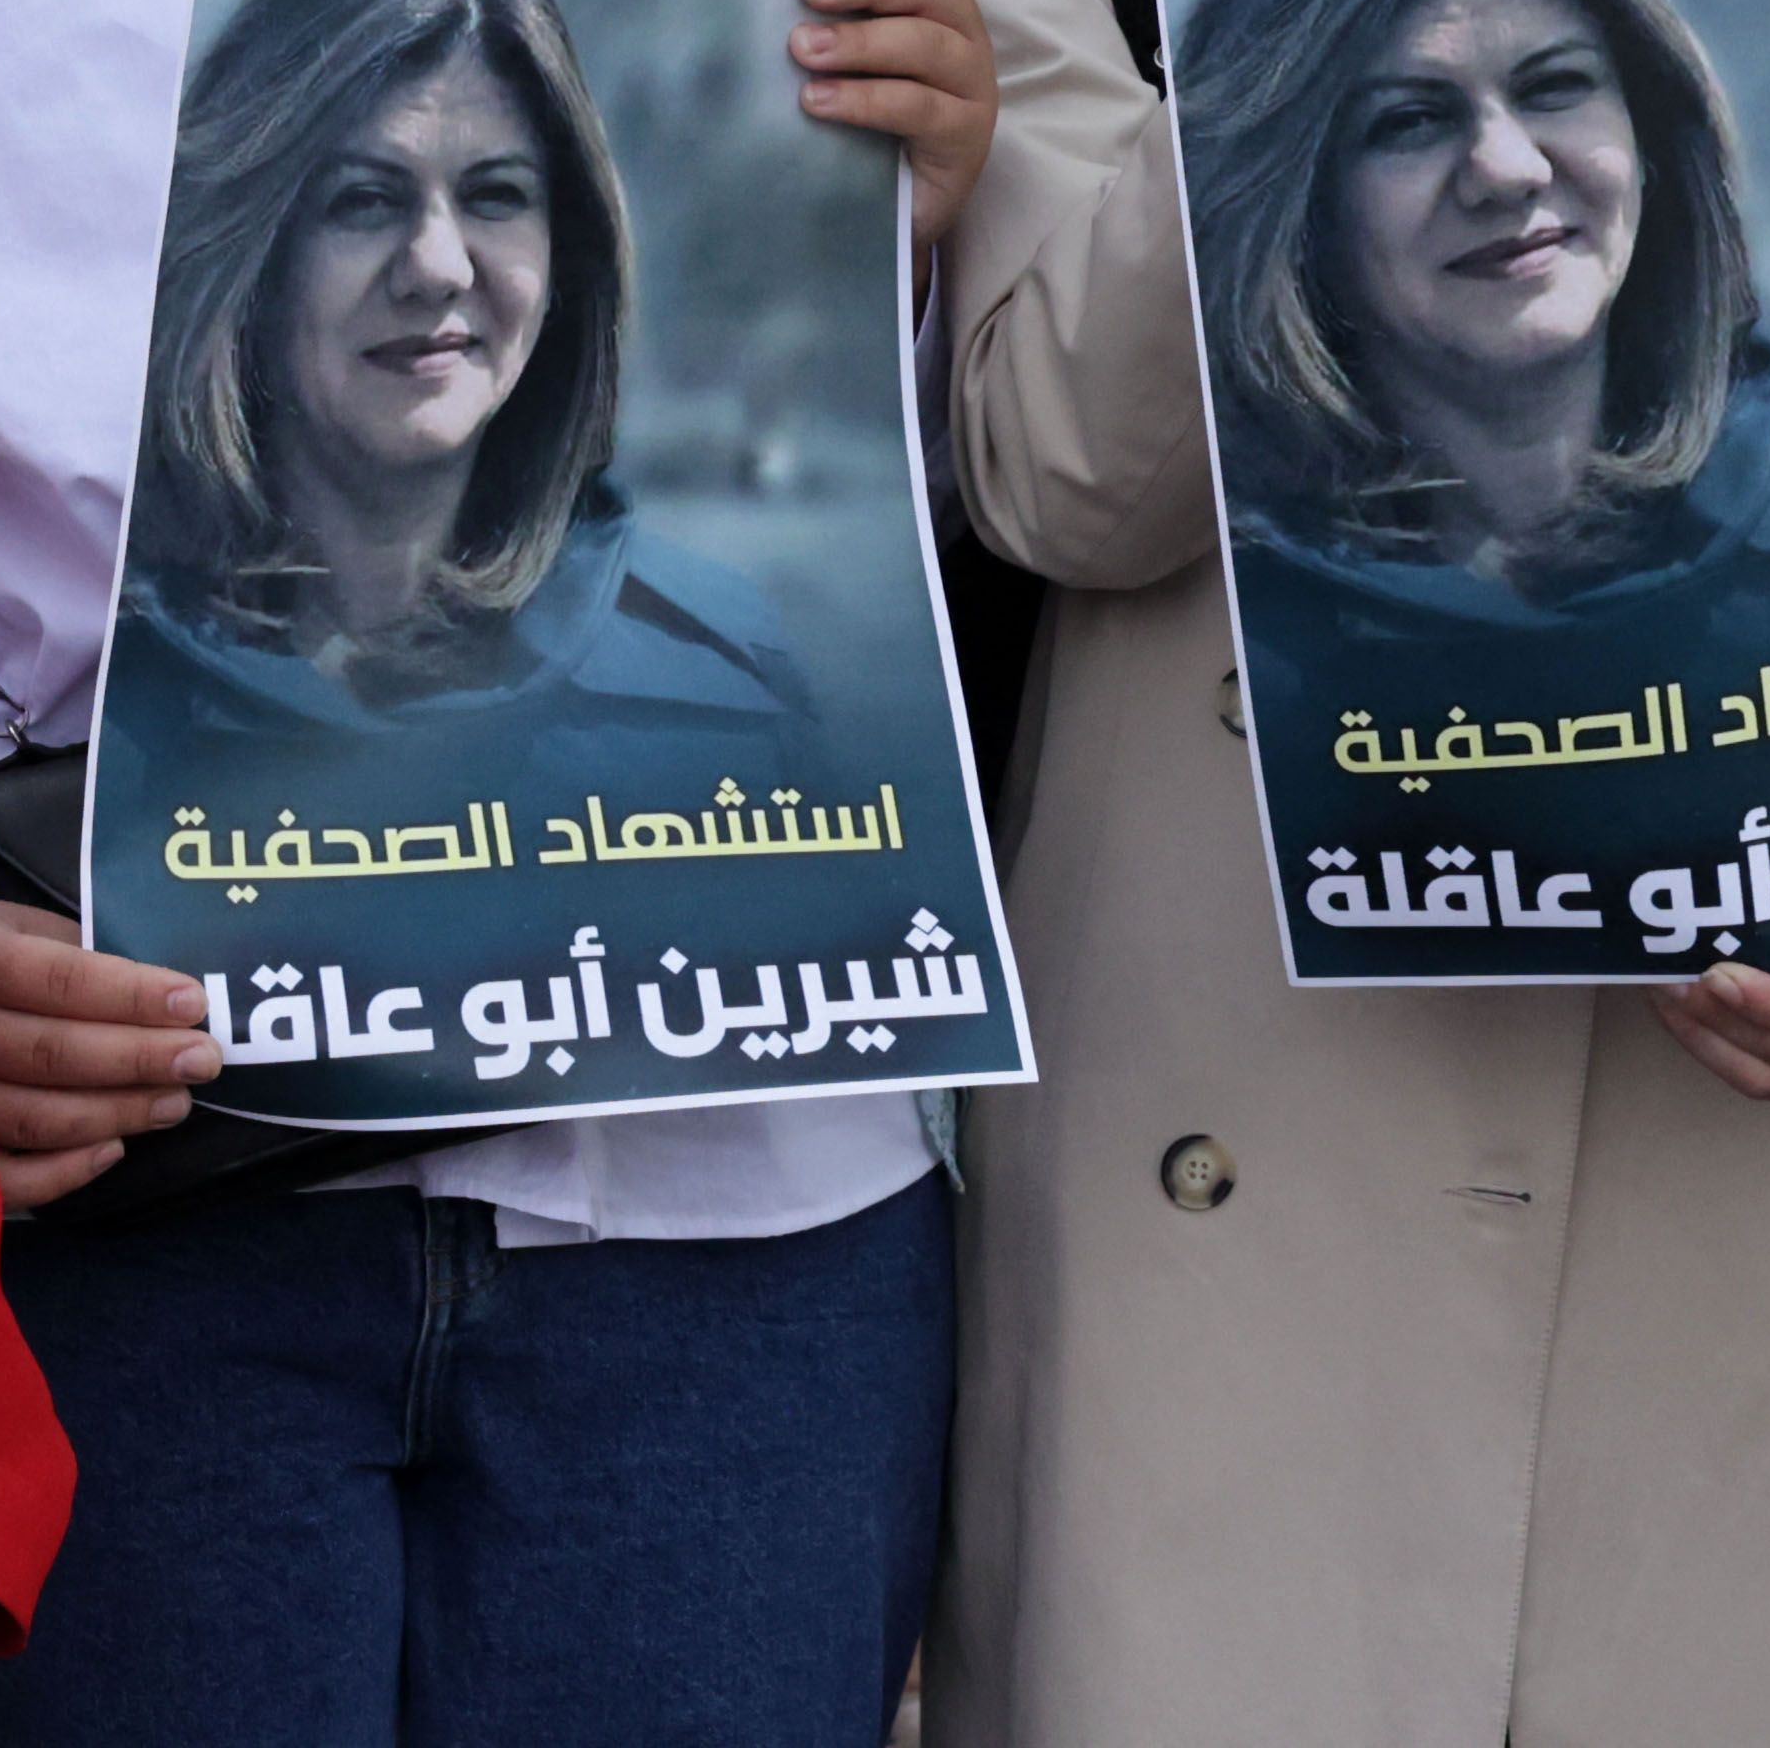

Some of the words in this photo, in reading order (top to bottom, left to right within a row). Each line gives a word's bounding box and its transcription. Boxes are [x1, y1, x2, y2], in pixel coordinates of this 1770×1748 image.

[1333, 682, 1688, 794] الصحفية
[163, 800, 514, 905] الصحفية
[538, 776, 904, 865] استشهاد
[1305, 845, 1604, 929] عاقلة
[203, 961, 436, 1066] عاقل
[459, 924, 613, 1081] أبو
[636, 906, 990, 1063] شيرين
